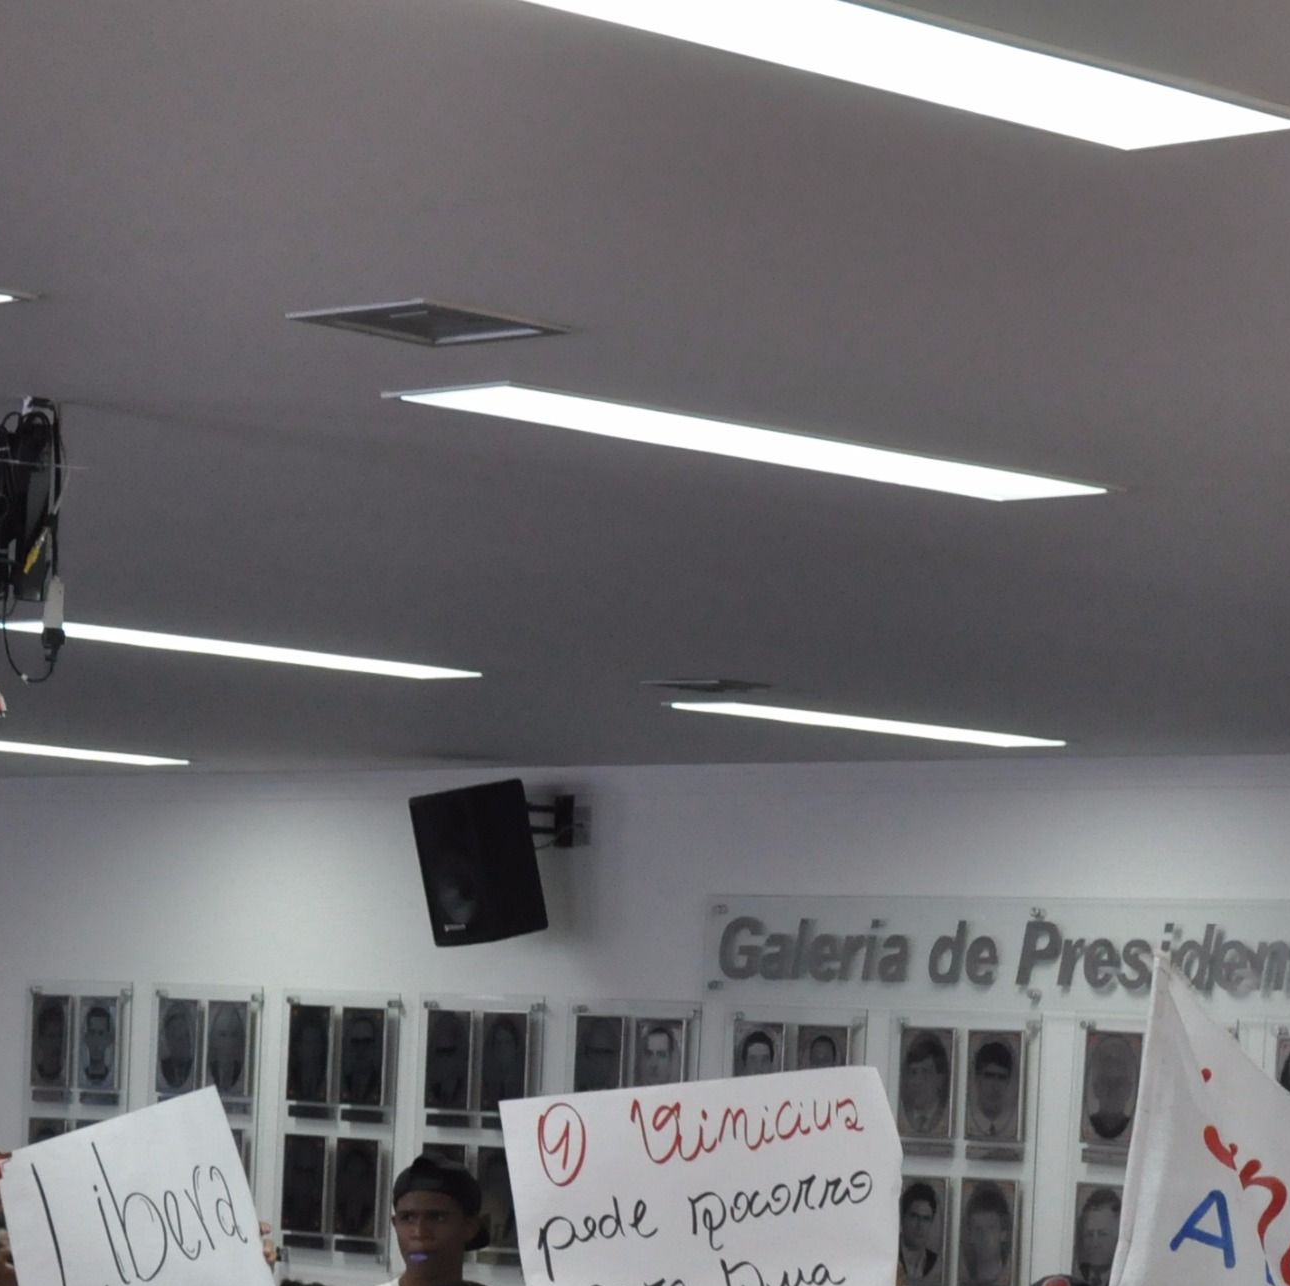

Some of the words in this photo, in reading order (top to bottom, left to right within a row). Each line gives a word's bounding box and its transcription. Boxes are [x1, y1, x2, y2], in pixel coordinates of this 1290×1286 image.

[719, 914, 911, 984] Galeria
[928, 919, 1000, 986] de
[630, 1098, 864, 1165] Vinicius
[537, 1196, 659, 1281] pede
[1169, 1190, 1236, 1270] A
